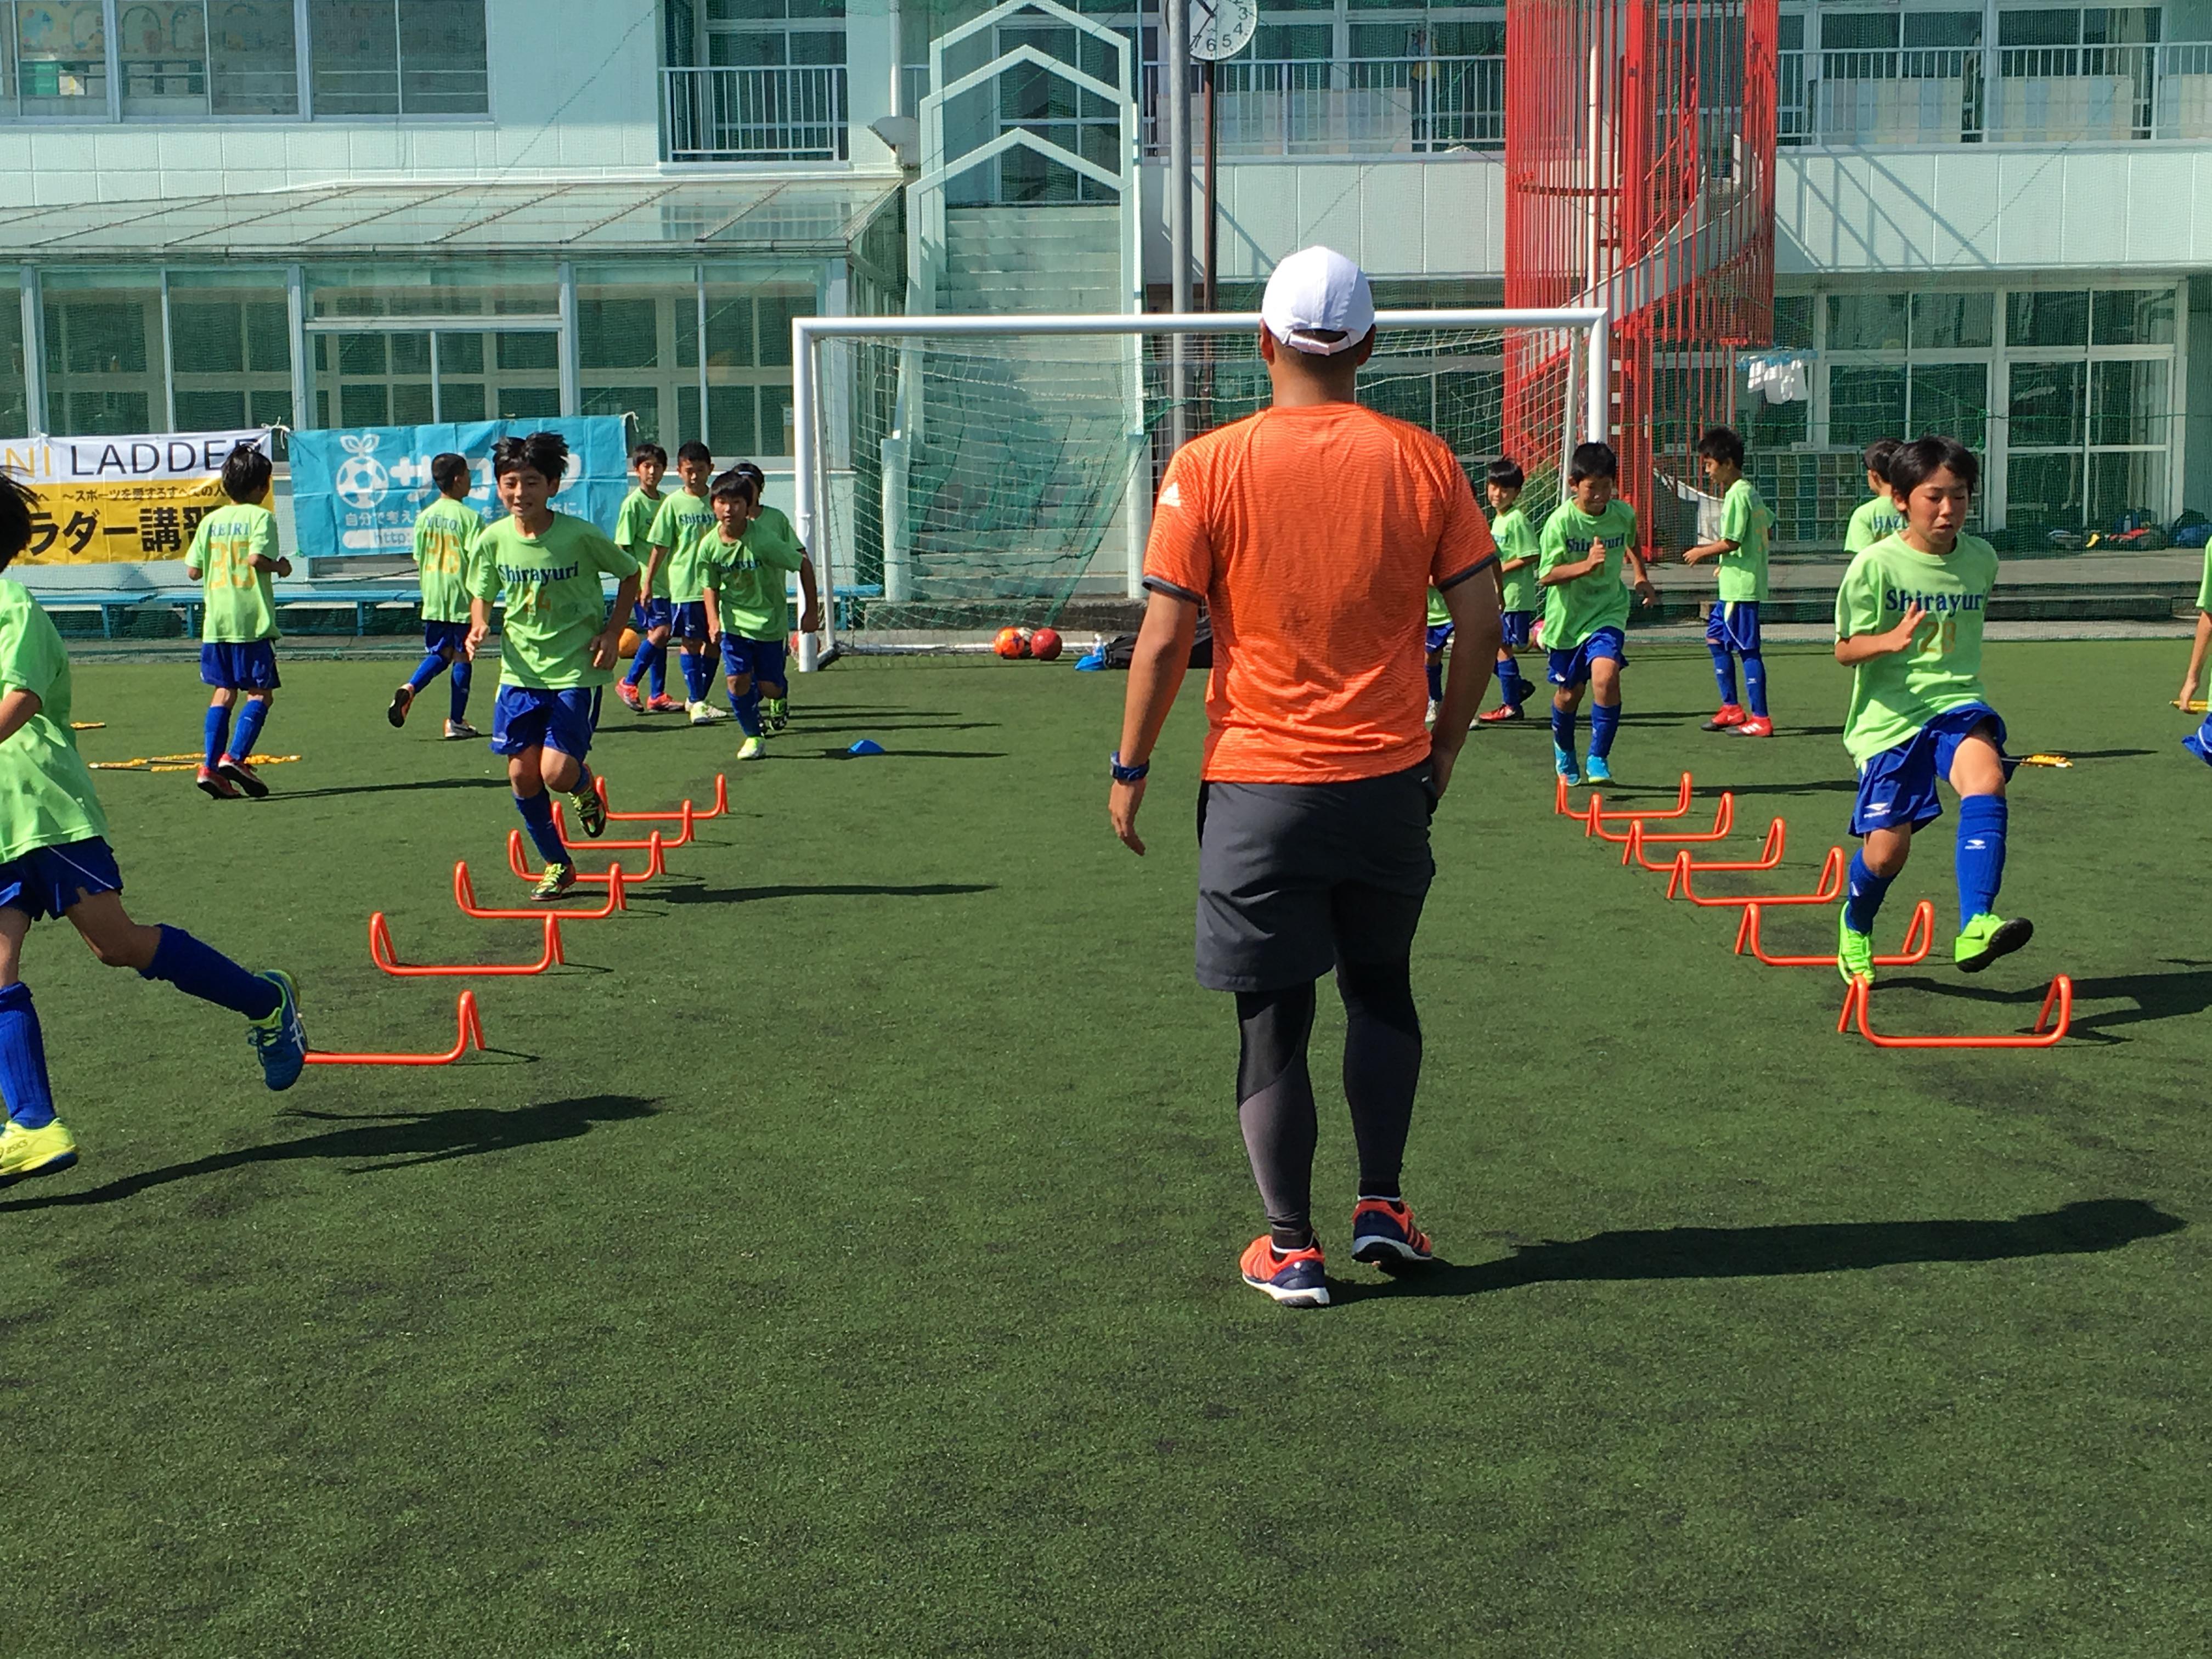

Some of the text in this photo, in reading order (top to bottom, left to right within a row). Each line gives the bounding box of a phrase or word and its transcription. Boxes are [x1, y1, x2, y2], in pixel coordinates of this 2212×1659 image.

[1238, 7, 1248, 20] 3
[1233, 22, 1243, 35] 4
[1206, 38, 1216, 52] 6
[1222, 34, 1232, 48] 5
[208, 540, 255, 590] 35
[498, 561, 578, 586] Shirayuri
